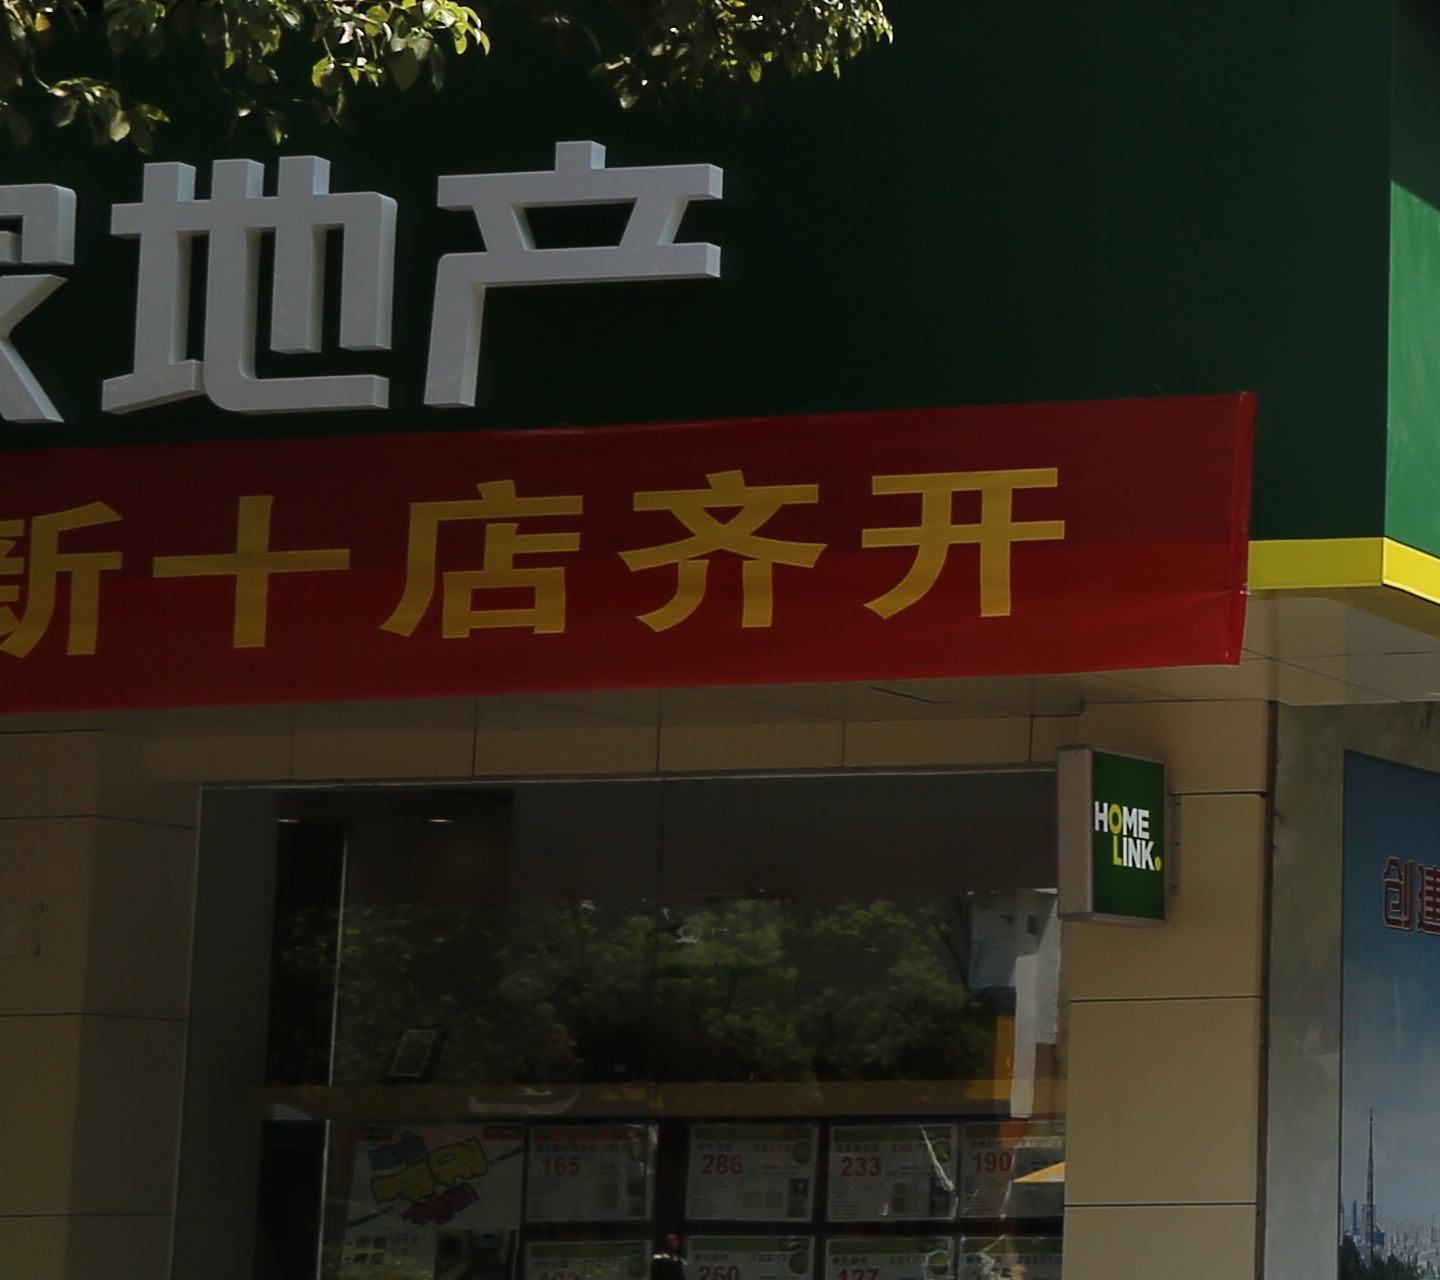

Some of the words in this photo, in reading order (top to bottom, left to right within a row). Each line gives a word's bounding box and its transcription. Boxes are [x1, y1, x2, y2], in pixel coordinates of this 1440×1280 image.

[0, 140, 724, 424] 地产
[1094, 800, 1150, 839] HOME
[541, 1156, 581, 1176] 165
[700, 1154, 743, 1174] 286
[840, 1156, 882, 1177] 233
[972, 1151, 1011, 1173] 190
